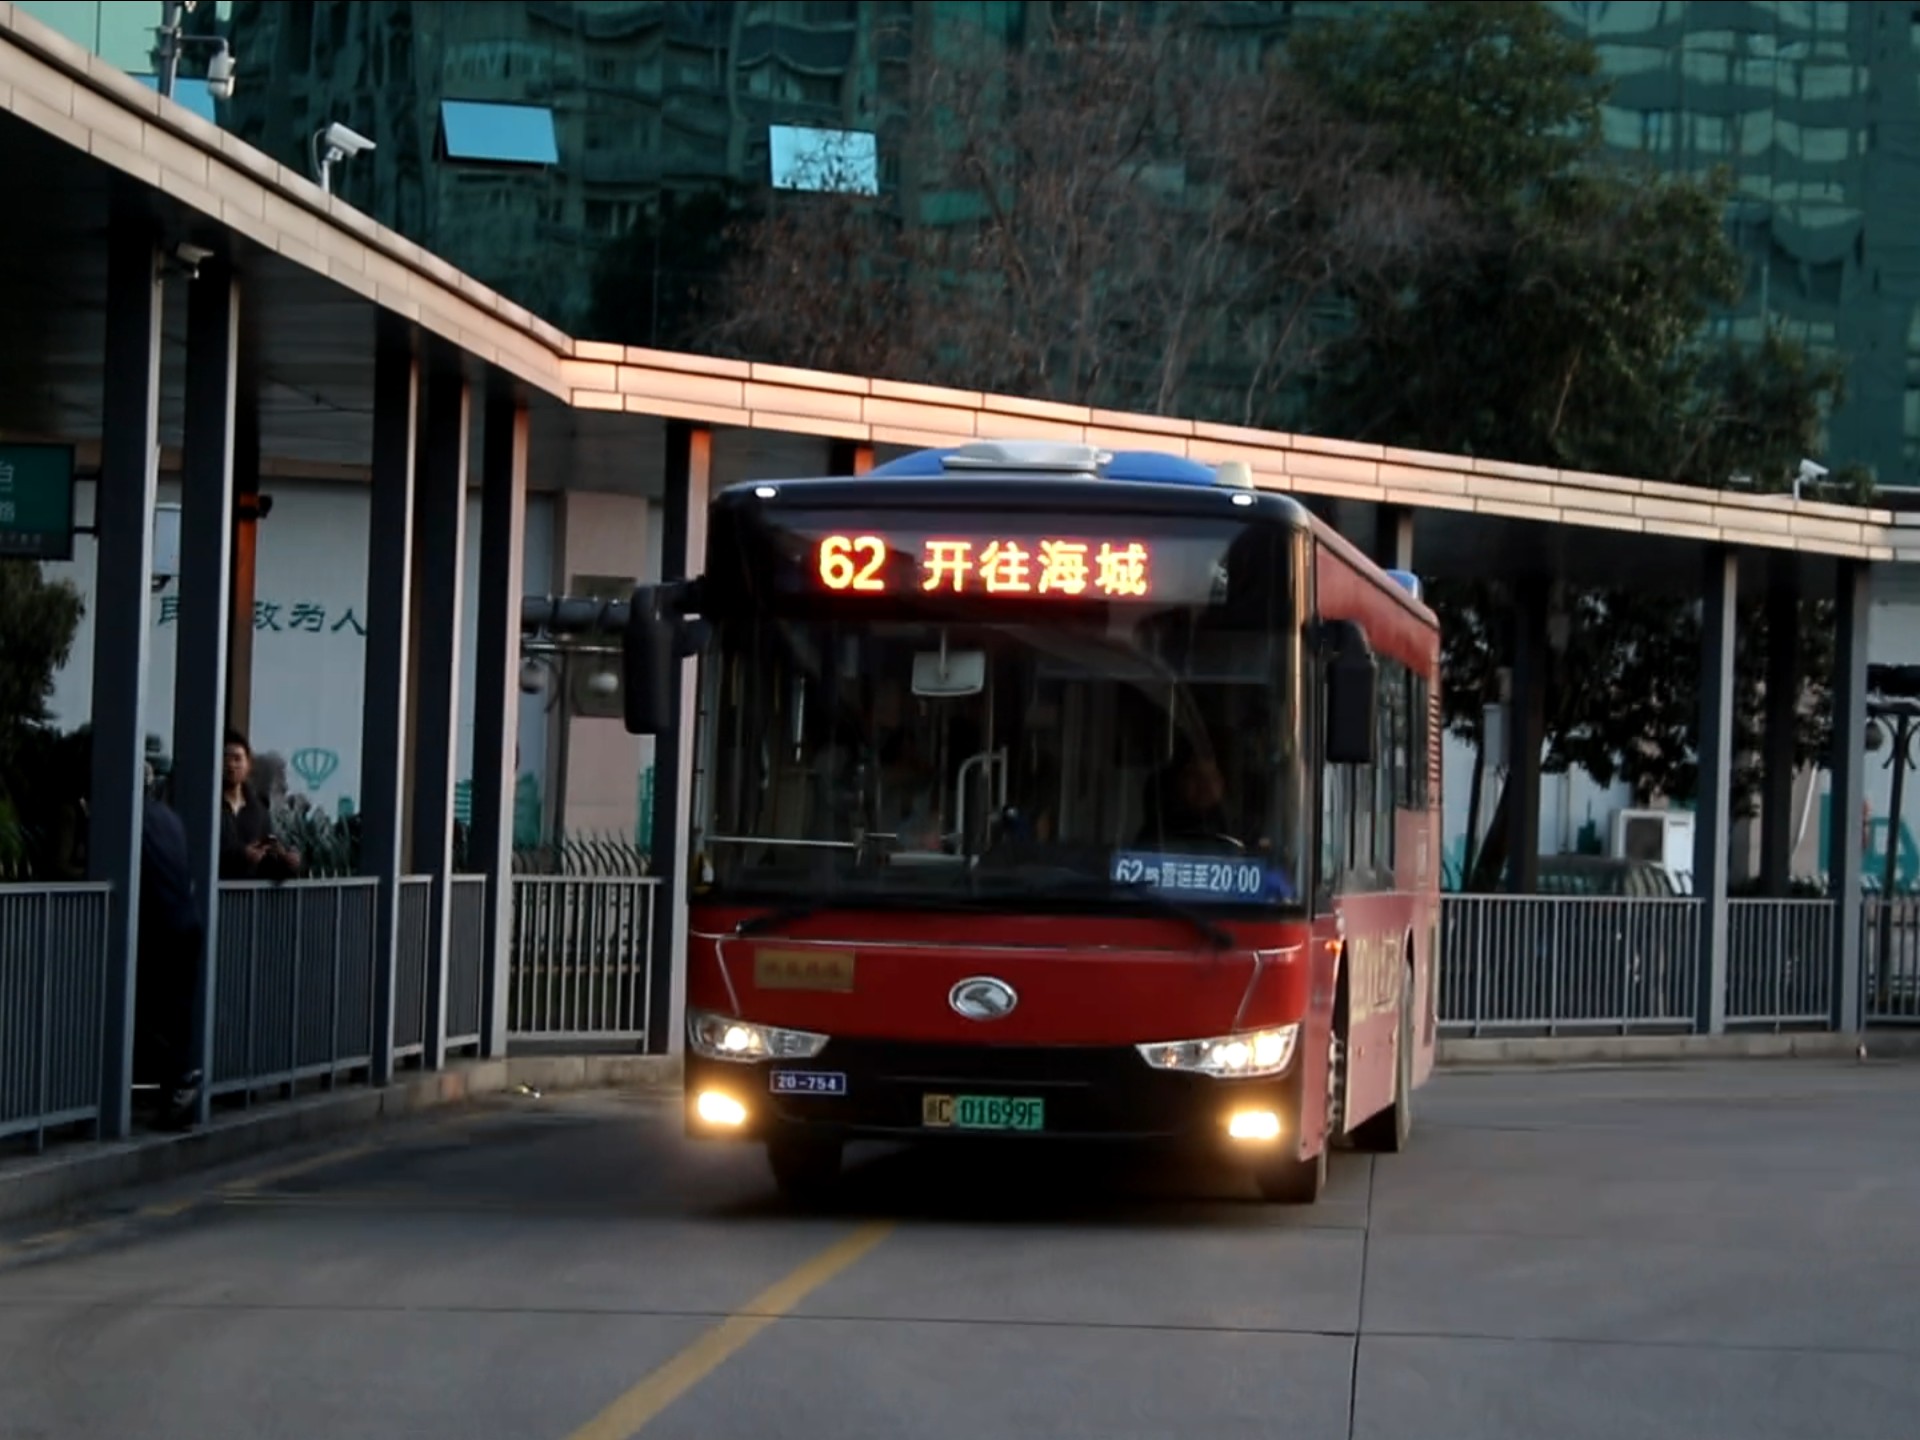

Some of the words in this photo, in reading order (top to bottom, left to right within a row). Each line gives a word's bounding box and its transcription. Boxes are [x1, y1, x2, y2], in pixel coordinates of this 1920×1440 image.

[819, 535, 886, 591] 62
[922, 539, 1149, 597] 开往海城
[776, 1075, 837, 1091] 20-754
